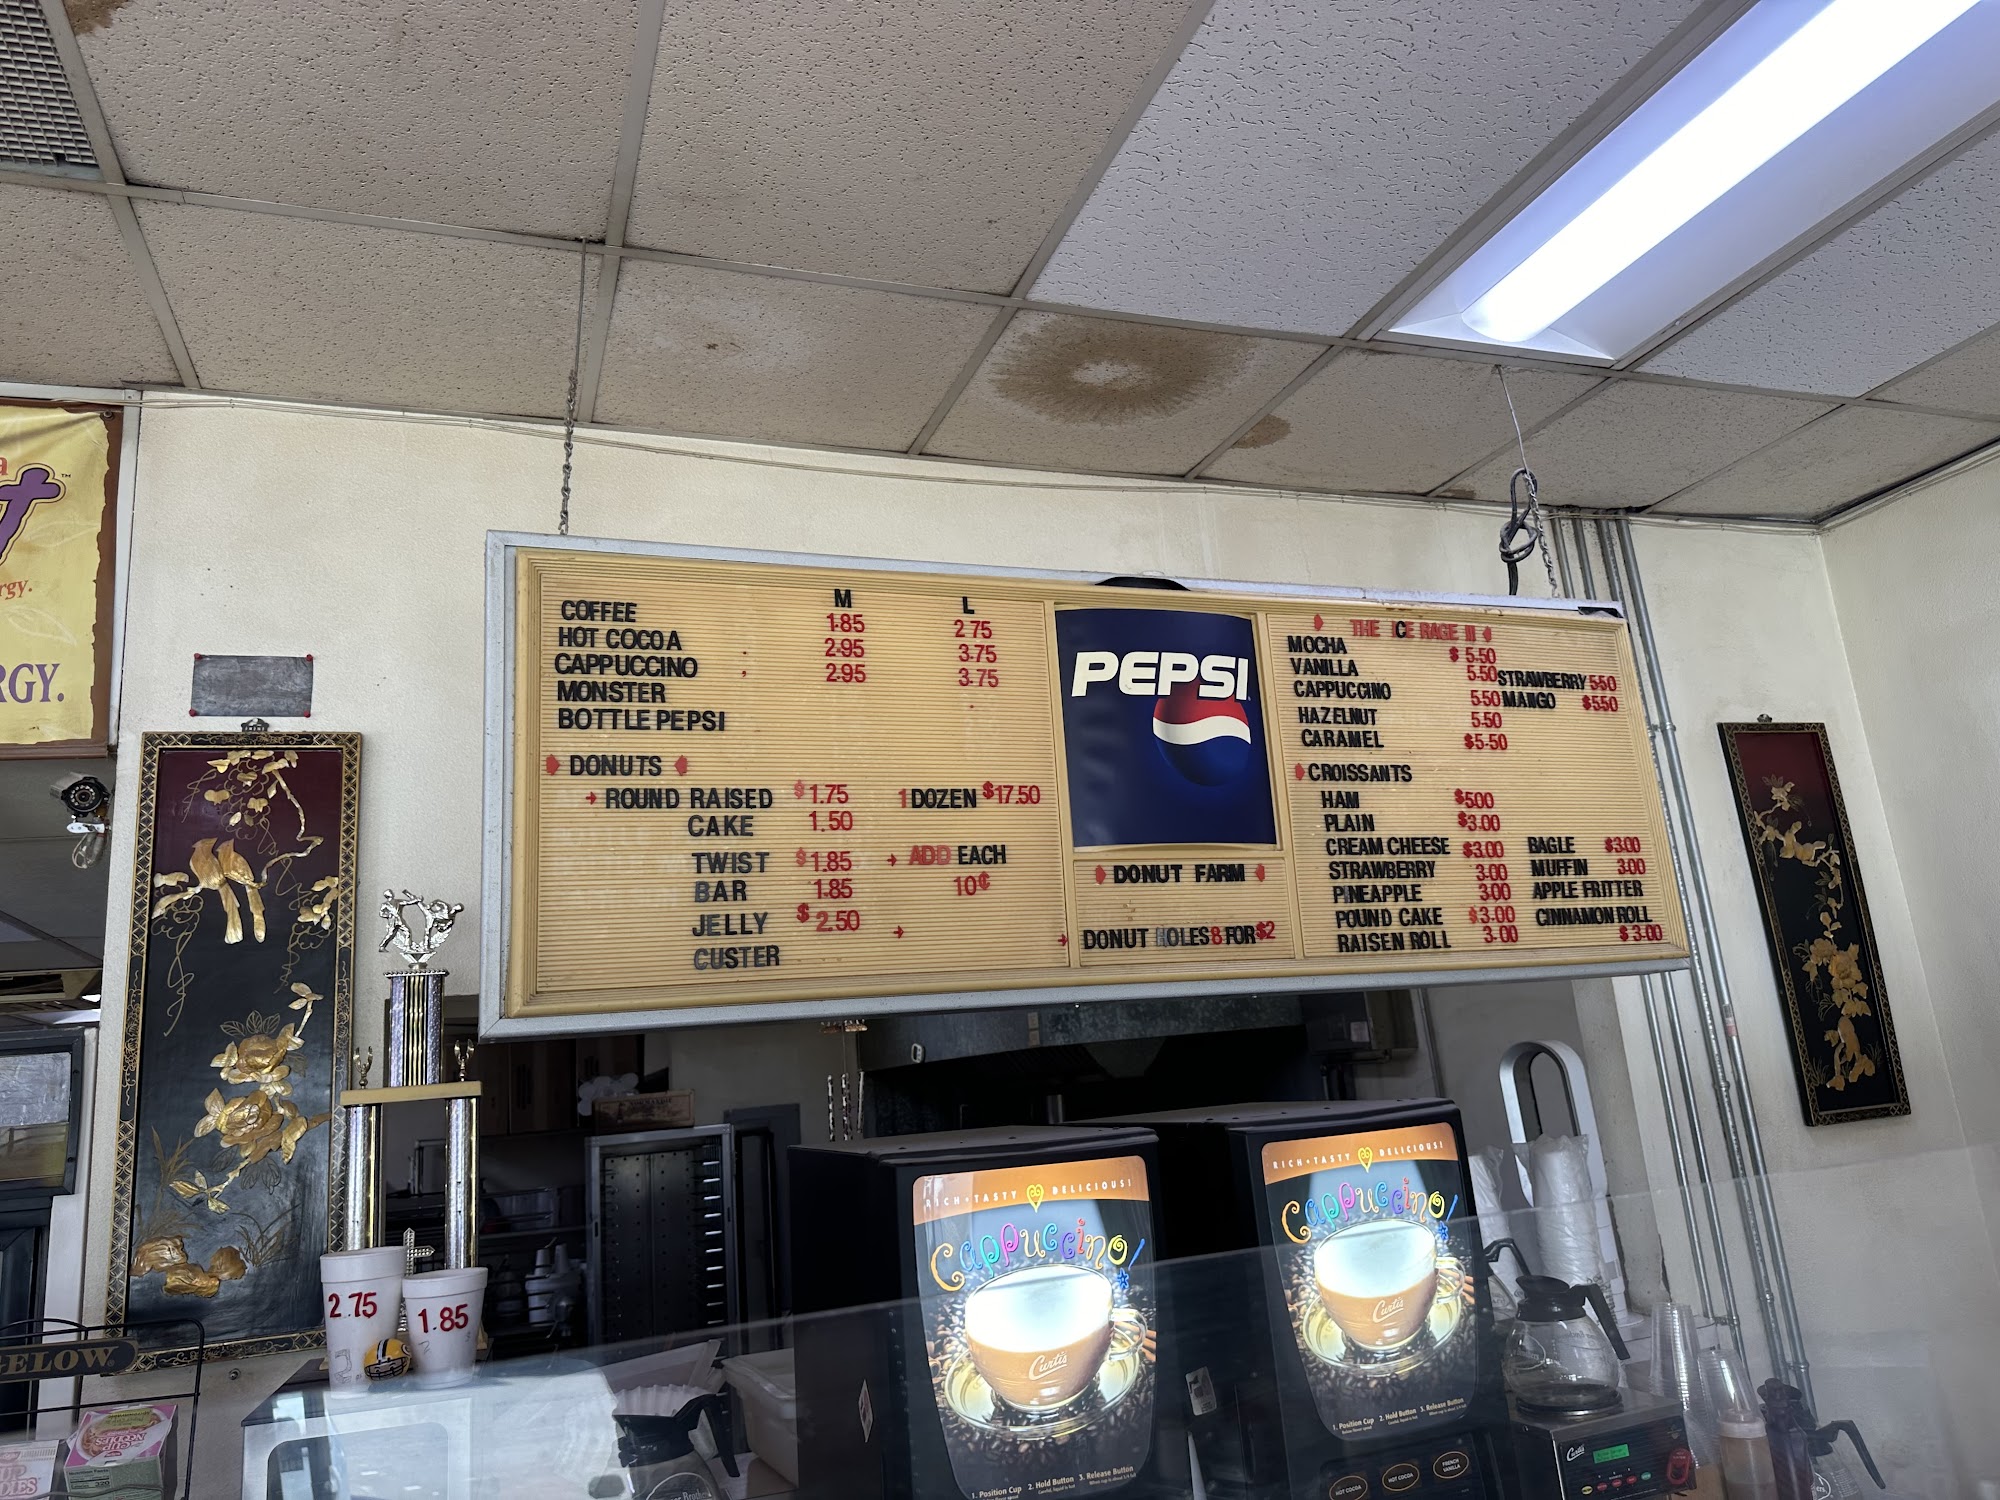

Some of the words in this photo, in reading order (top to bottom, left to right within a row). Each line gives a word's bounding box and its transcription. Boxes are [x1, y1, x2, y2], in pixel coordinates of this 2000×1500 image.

[834, 588, 852, 608] M
[962, 596, 975, 615] L
[561, 600, 637, 622] COFFEE
[826, 613, 865, 633] 1.85
[1350, 619, 1380, 637] THE
[1420, 622, 1460, 641] RAGE
[558, 626, 599, 648] HOT
[605, 628, 682, 651] COCOA
[824, 638, 865, 658] 2.95
[958, 643, 997, 664] 3.75
[1287, 635, 1347, 654] MOCHA
[554, 653, 698, 678] CAPPUCCINO
[825, 663, 866, 683] 2.95
[958, 667, 999, 688] 3.75
[1071, 651, 1249, 701] PEPSI
[1290, 658, 1359, 677] VANILLA
[1294, 680, 1391, 700] CAPPUCCINO
[1497, 670, 1586, 690] STRAWBERRY
[557, 680, 666, 703] MONSTER
[1501, 691, 1556, 709] MANGO
[558, 708, 650, 730] BOTTLE
[656, 710, 725, 731] PEPSI
[1298, 706, 1378, 726] HAZELNUT
[1302, 729, 1384, 748] CARAMEL
[570, 755, 662, 776] DONUTS
[1308, 763, 1412, 782] CROISSANTS
[605, 787, 680, 809] ROUND
[690, 787, 773, 809] RAISED
[911, 788, 977, 809] DOZEN
[1321, 790, 1360, 809] HAM
[688, 814, 754, 837] CAKE
[809, 810, 853, 832] 1.50
[1324, 814, 1375, 832] PLAIN
[909, 845, 950, 865] ADD
[958, 844, 1007, 865] EACH
[1326, 837, 1384, 856] CREAM
[1387, 837, 1451, 855] CHEESE
[1527, 836, 1576, 854] BAGLE
[692, 851, 770, 874] TWIST
[1329, 860, 1436, 880] STRAWBERRY
[1530, 859, 1589, 877] MUFFIN
[1114, 864, 1183, 883] DONUT
[1195, 864, 1246, 883] FARM
[694, 880, 747, 903] BAR
[813, 878, 853, 899] 1.85
[1333, 883, 1423, 903] PINEAPPLE
[1532, 881, 1579, 900] APPLE
[1582, 880, 1644, 899] FRITTER
[692, 912, 768, 936] JELLY
[1336, 908, 1392, 929] POUND
[1400, 907, 1444, 926] CAKE
[1535, 907, 1615, 927] CINNAMON
[1617, 906, 1653, 923] ROLL
[1083, 928, 1149, 950] DONUT
[1156, 926, 1210, 948] HOLES
[1225, 925, 1256, 945] FOR
[1337, 932, 1405, 953] RAISEN
[1410, 930, 1451, 950] ROLL
[693, 944, 780, 970] CUSTER
[1379, 1141, 1444, 1157] DELICIOUS!
[1052, 1178, 1132, 1195] DELICIOUS!
[328, 1291, 378, 1319] 2.75
[1372, 1296, 1404, 1323] Curtis
[418, 1303, 469, 1333] 1.85
[0, 1345, 119, 1375] ELOW
[1028, 1351, 1068, 1381] Curtis
[1338, 1419, 1362, 1430] Position
[1363, 1417, 1375, 1426] Cup
[1385, 1411, 1398, 1420] Hold
[1086, 1468, 1111, 1479] Release
[1112, 1464, 1134, 1475] Button
[1398, 1472, 1415, 1481] COCOA
[979, 1487, 1007, 1498] Position
[1008, 1485, 1022, 1495] Cup
[1035, 1479, 1051, 1489] Hold
[1052, 1476, 1074, 1486] Button
